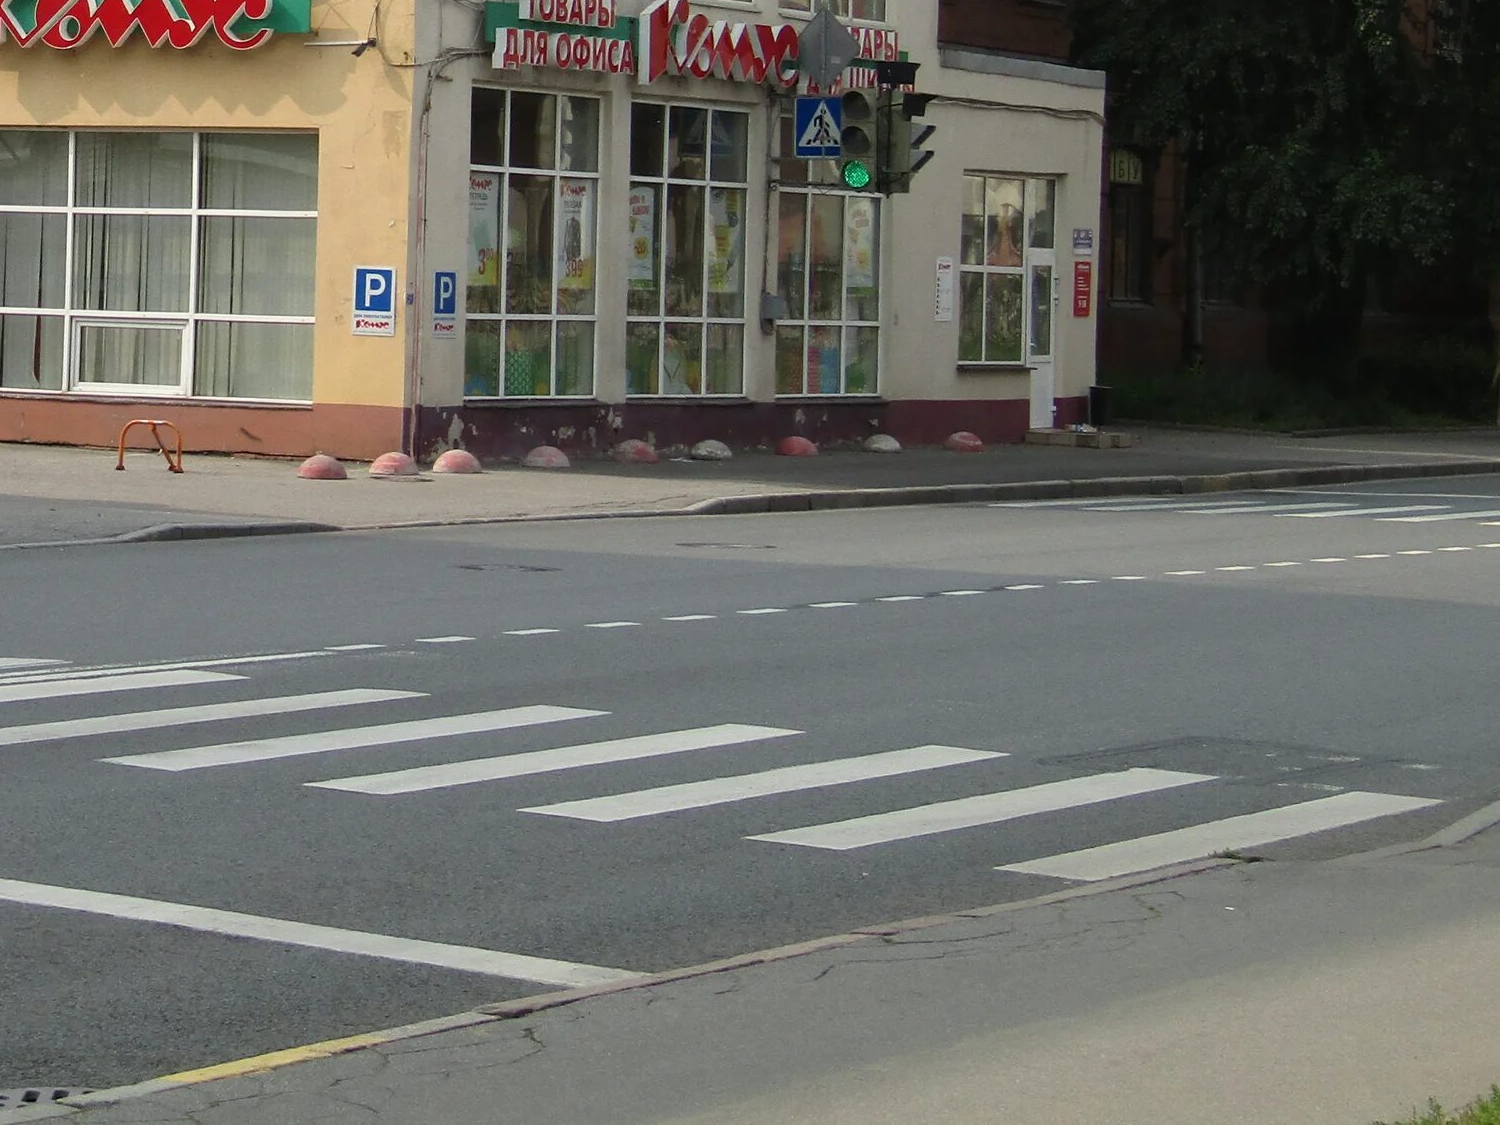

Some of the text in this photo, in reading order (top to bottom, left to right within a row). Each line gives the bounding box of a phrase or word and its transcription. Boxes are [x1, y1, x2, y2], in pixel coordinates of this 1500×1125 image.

[503, 28, 634, 75] ДЛЯ ОФИСА
[364, 273, 386, 307] P
[440, 276, 453, 310] P
